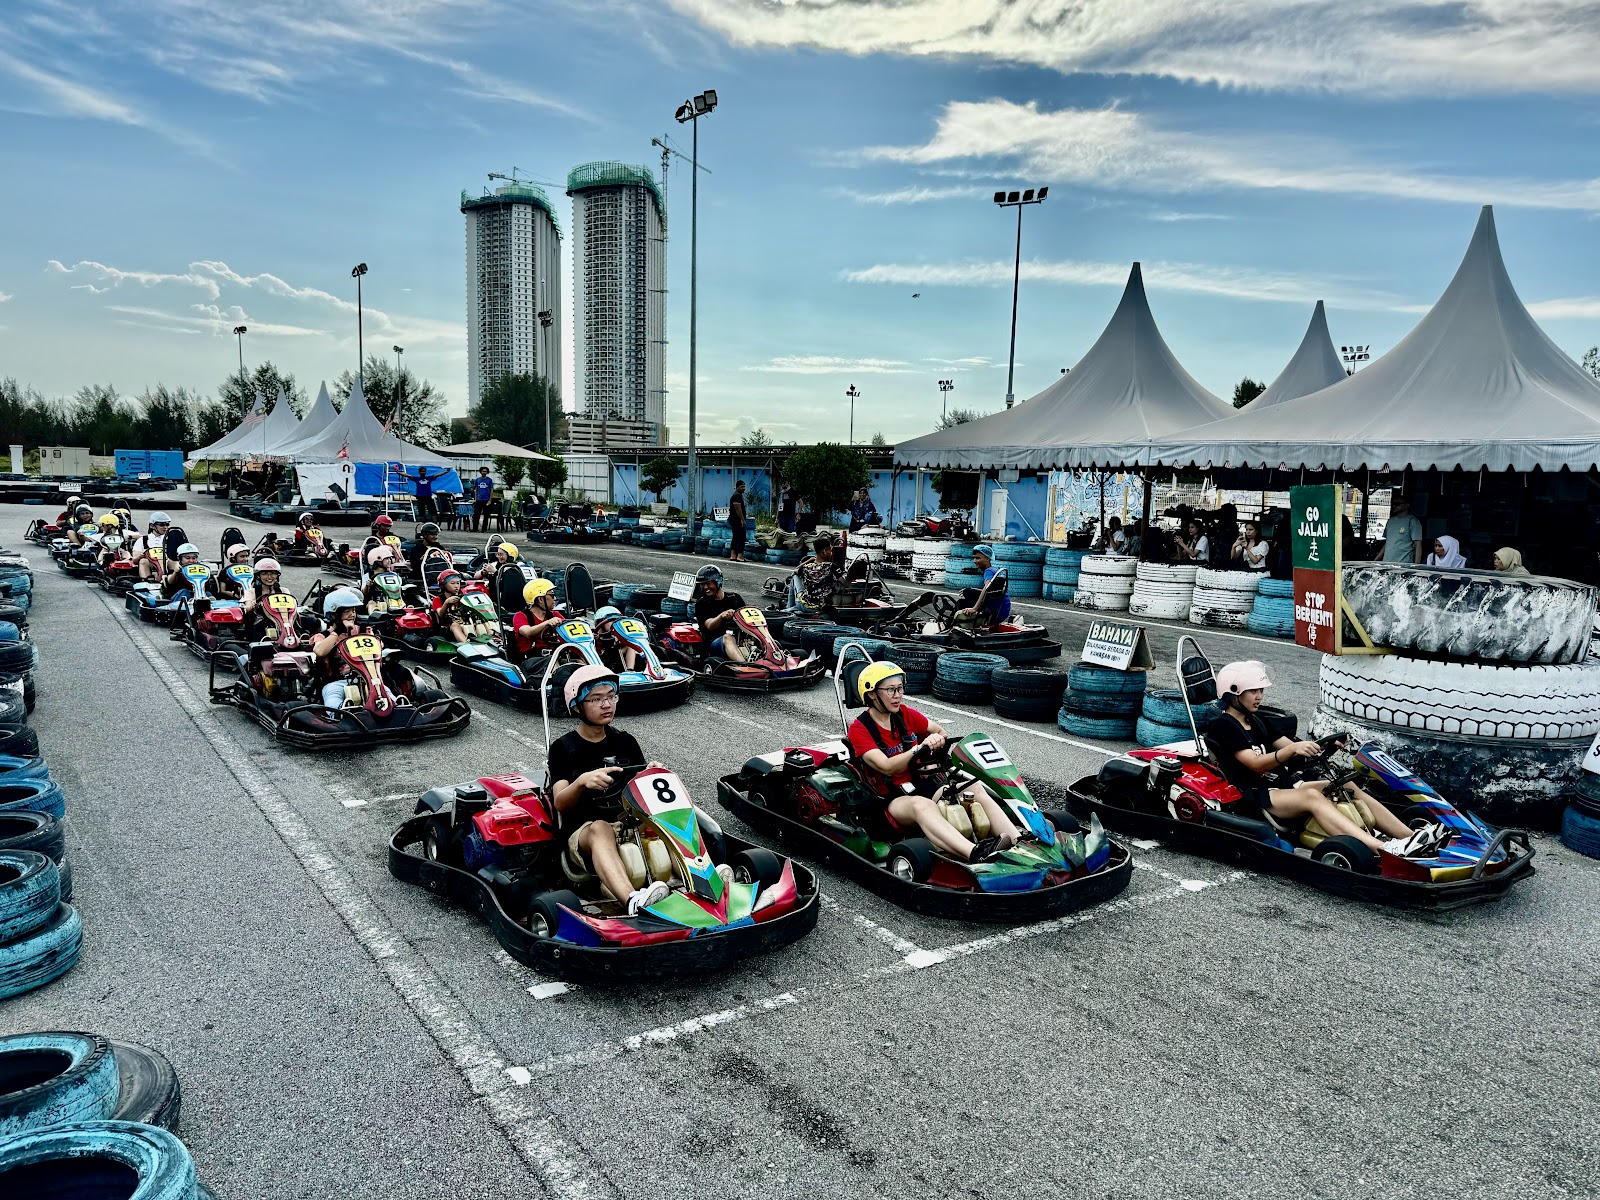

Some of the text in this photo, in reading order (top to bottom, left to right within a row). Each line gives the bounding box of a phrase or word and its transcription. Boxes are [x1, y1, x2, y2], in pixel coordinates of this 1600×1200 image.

[1306, 506, 1319, 522] GO
[1297, 522, 1329, 538] JALAN
[1307, 538, 1320, 561] 走
[233, 566, 252, 574] 22
[383, 576, 397, 585] 6
[273, 596, 290, 604] 11
[475, 596, 485, 605] 1
[1305, 591, 1326, 609] STOP
[745, 608, 760, 618] 13
[1295, 604, 1334, 628] BERHENTI
[566, 623, 591, 636] 21
[1091, 624, 1134, 645] BAHAYA
[1307, 623, 1317, 645] 停
[352, 638, 374, 649] 18
[973, 741, 1005, 764] 2
[652, 777, 677, 804] 8
